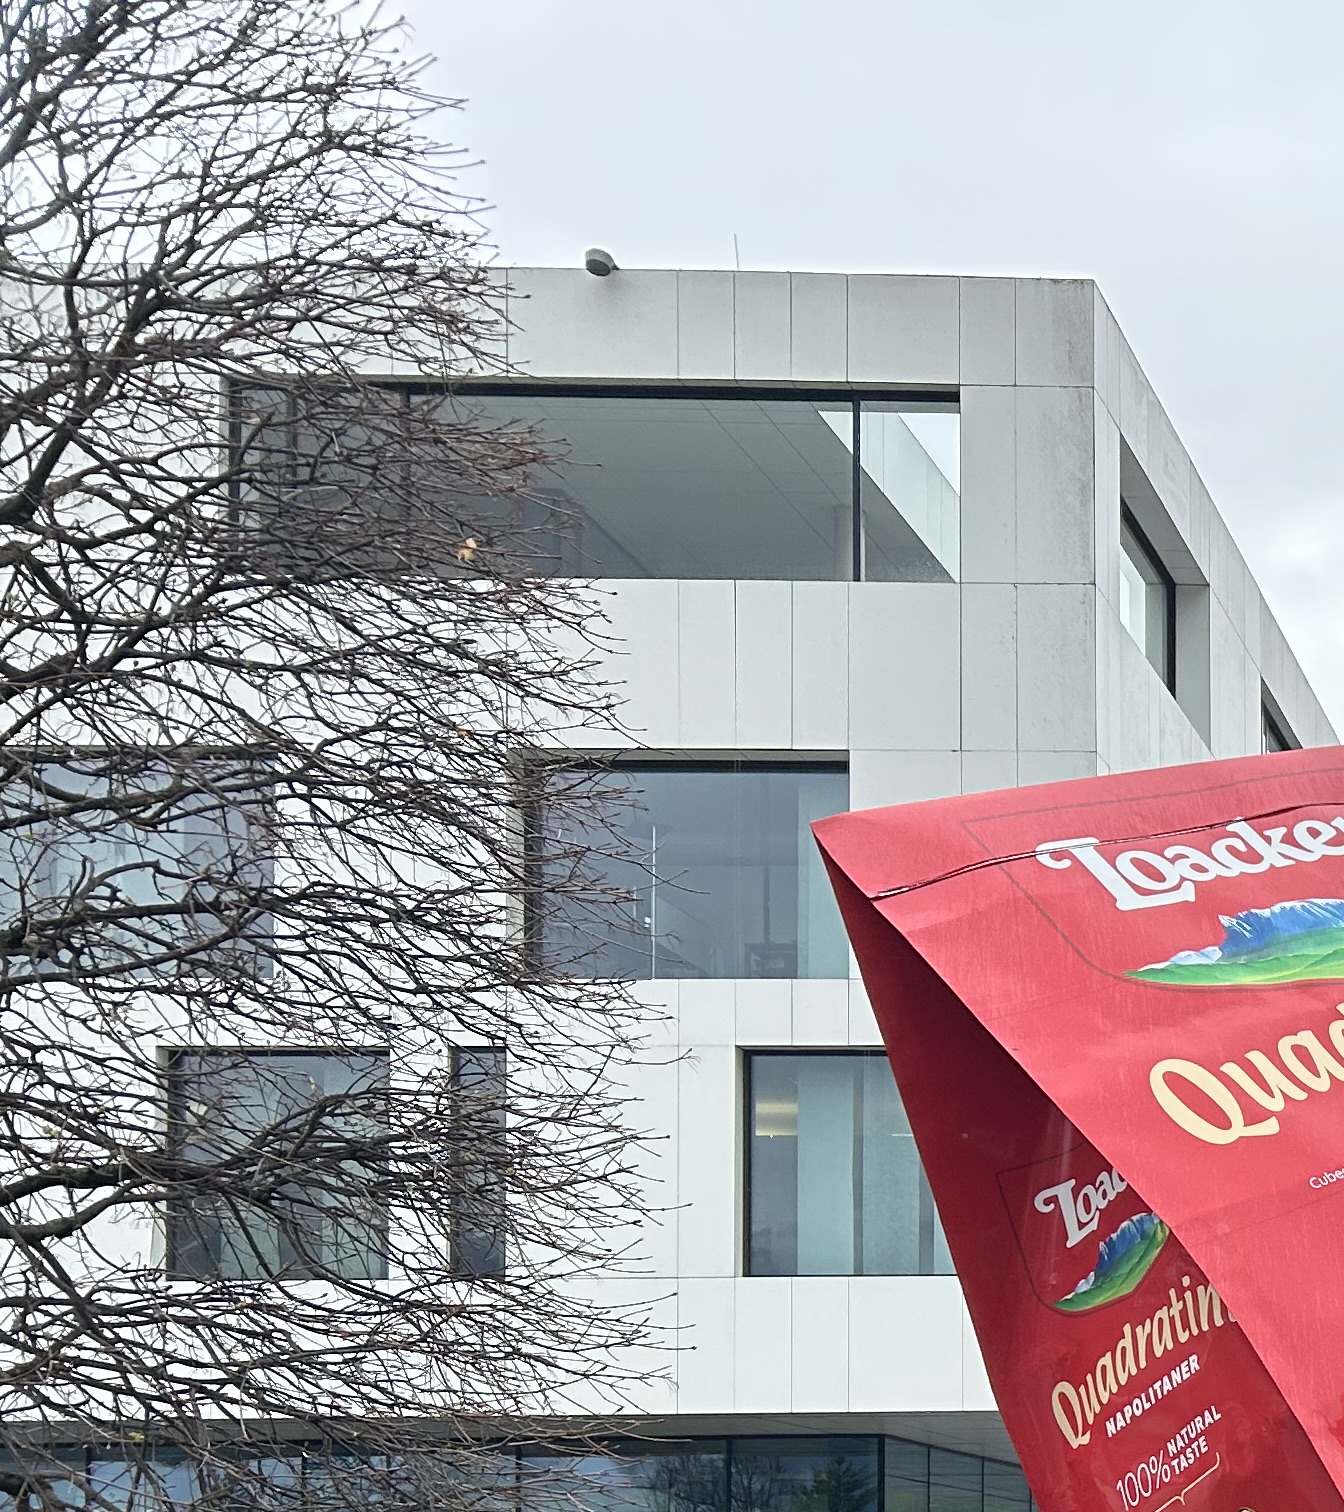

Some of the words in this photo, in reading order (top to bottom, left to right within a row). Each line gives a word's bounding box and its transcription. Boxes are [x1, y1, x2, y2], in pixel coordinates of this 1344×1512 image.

[1033, 1166, 1128, 1248] Loac
[1051, 1275, 1238, 1449] Quadratin
[1105, 1353, 1200, 1438] NAPOLITANER
[1116, 1449, 1171, 1511] 100%
[1167, 1405, 1222, 1457] NATURAL
[1171, 1435, 1209, 1475] TASTE
